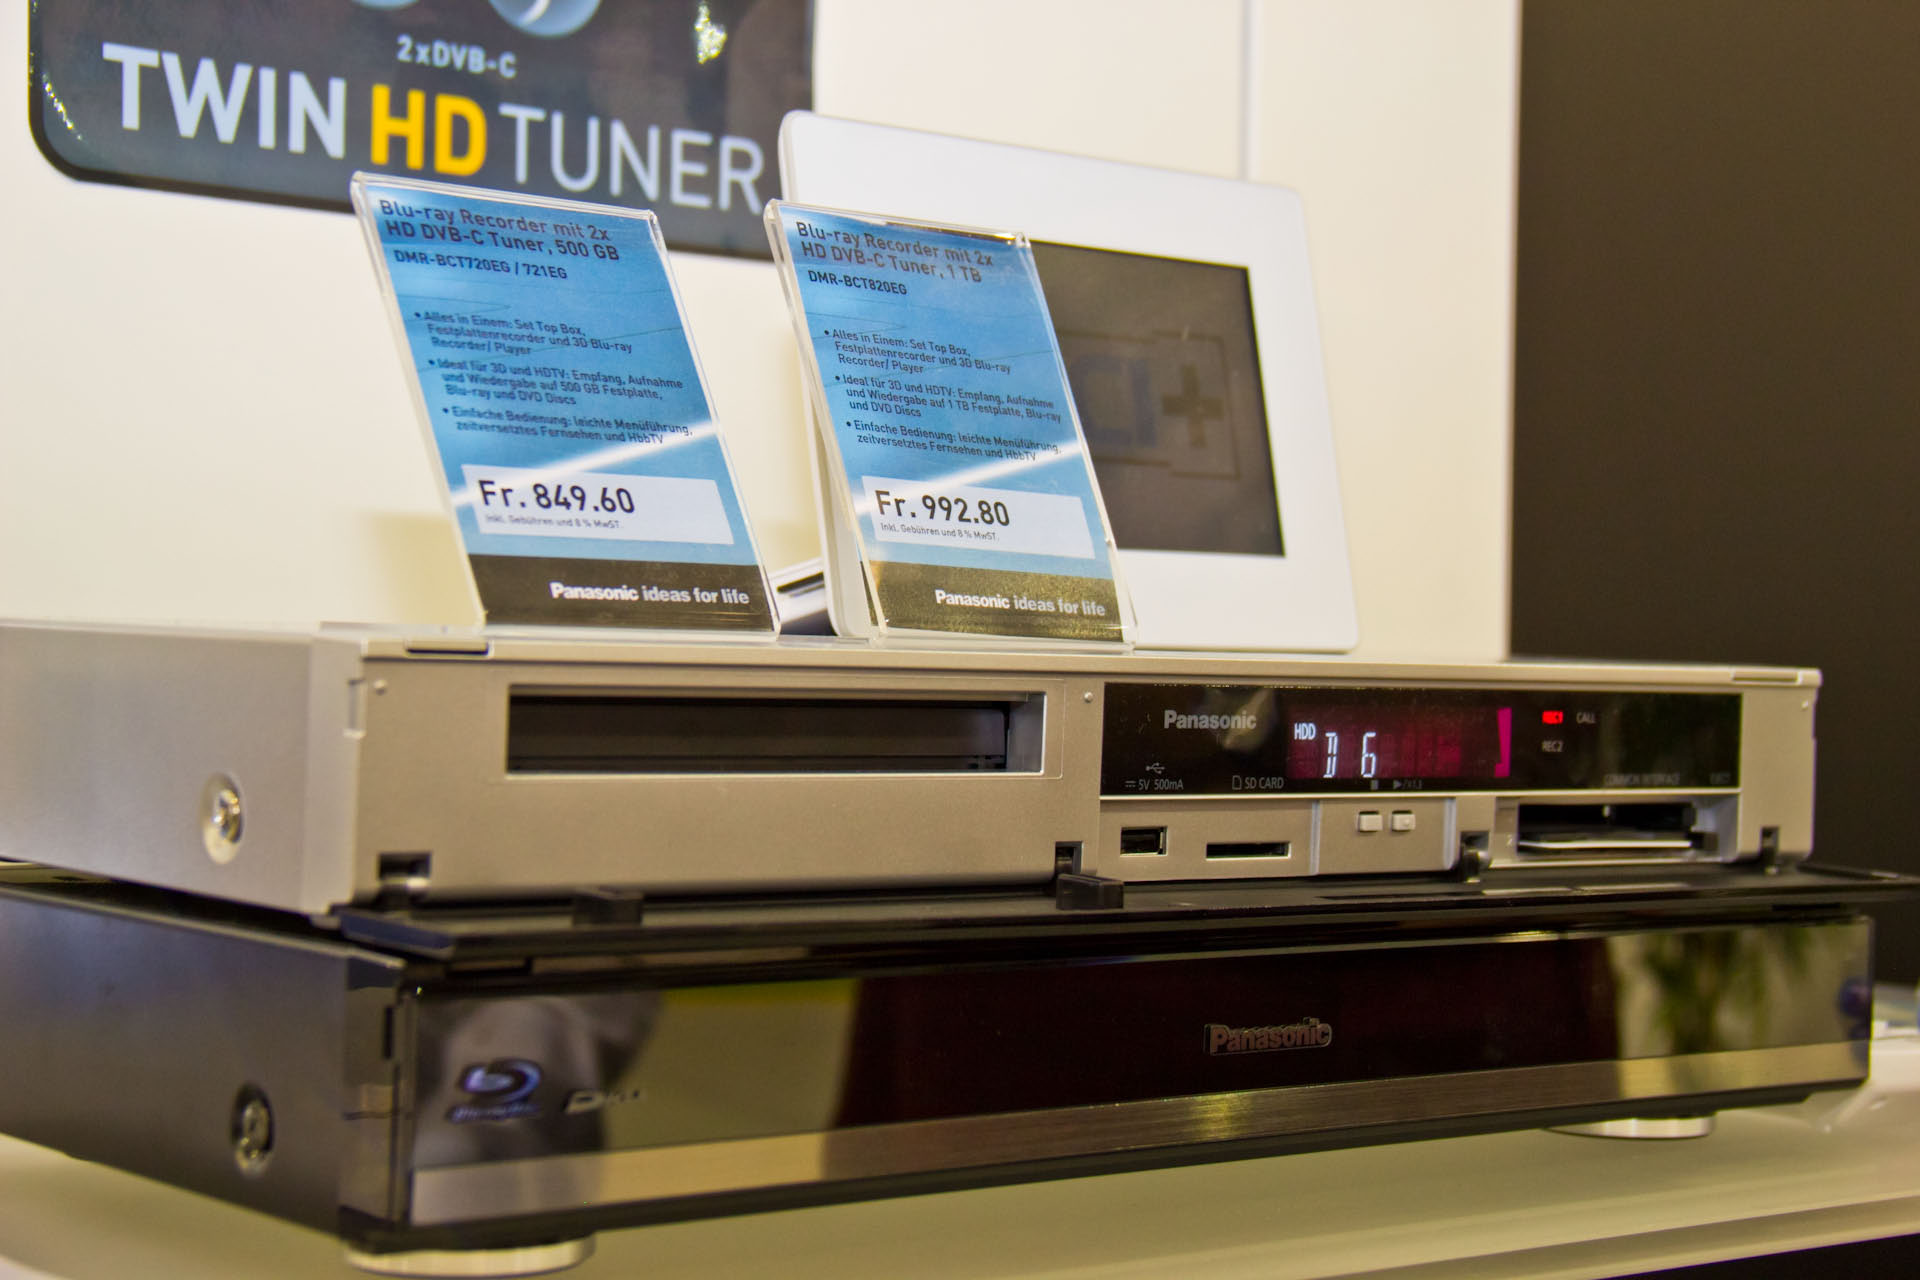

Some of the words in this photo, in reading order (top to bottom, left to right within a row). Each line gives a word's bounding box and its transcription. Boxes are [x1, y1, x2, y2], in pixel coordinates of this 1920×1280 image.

[397, 34, 518, 79] 2xDVB-C
[102, 41, 346, 159] TWIN
[370, 83, 487, 176] HD
[499, 103, 763, 215] TUNER
[380, 200, 454, 225] Blu-ray
[460, 208, 547, 233] Recorder
[553, 222, 585, 238] mit
[588, 225, 610, 241] 2x
[386, 220, 415, 237] HD
[421, 223, 484, 245] DVB-C
[487, 231, 552, 255] Tuner,
[555, 240, 589, 257] 500
[594, 245, 620, 260] GB
[796, 221, 860, 248] Blu-ray
[864, 232, 940, 258] Recorder
[944, 247, 971, 264] mit
[975, 250, 994, 266] 2x
[394, 250, 510, 273] DMR-BCT720EG
[522, 264, 568, 279] 721EG
[801, 241, 827, 258] HD
[831, 245, 886, 268] DVB-C
[888, 254, 945, 279] Tuner,
[946, 264, 955, 279] 1
[960, 266, 983, 283] TB
[808, 270, 908, 295] DMR-BCT820EG
[515, 319, 534, 330] Set
[536, 321, 558, 334] Top
[560, 324, 586, 336] Box,
[549, 336, 570, 346] und
[573, 337, 588, 348] 3D
[590, 339, 632, 354] Blu-ray
[833, 329, 859, 341] Alles
[861, 333, 871, 343] in
[872, 333, 909, 348] Einem:
[909, 338, 927, 350] Set
[927, 341, 947, 354] Top
[949, 343, 971, 356] Box,
[835, 341, 936, 363] Festplattenrecorder
[938, 355, 957, 366] und
[959, 357, 972, 368] 3D
[974, 359, 1011, 375] Blu-ray
[838, 353, 889, 370] Recorder/
[891, 360, 924, 375] Player
[491, 362, 506, 374] 3D
[510, 366, 531, 376] und
[628, 375, 683, 389] Aufnahme
[540, 381, 557, 391] auf
[560, 381, 581, 392] 500
[584, 383, 600, 394] GB
[518, 391, 543, 402] DVD
[545, 393, 576, 405] Discs
[843, 374, 870, 386] Ideal
[870, 376, 886, 388] für
[888, 379, 902, 391] 3D
[904, 383, 923, 393] und
[925, 384, 955, 397] HDTV:
[958, 388, 1005, 405] Empfang,
[1006, 394, 1055, 409] Aufnahme
[846, 388, 866, 398] und
[868, 389, 928, 406] Wiedergabe
[929, 398, 946, 409] auf
[948, 399, 954, 409] 1
[957, 400, 970, 411] TB
[971, 401, 1025, 419] Festplatte,
[1025, 408, 1062, 425] Blu-ray
[849, 400, 869, 411] und
[871, 401, 893, 413] DVD
[895, 404, 922, 417] Discs
[604, 432, 626, 442] und
[628, 431, 663, 444] HbbTV
[853, 420, 898, 435] Einfache
[899, 425, 957, 444] Bedienung:
[958, 432, 992, 446] leichte
[857, 434, 928, 450] zeitversetztes
[929, 441, 983, 457] Fernsehen
[985, 447, 1003, 458] und
[1006, 449, 1036, 461] HbbTV
[478, 479, 526, 508] Fr.
[532, 483, 635, 513] 849.60
[875, 489, 917, 518] Fr.
[921, 494, 1010, 527] 992.80
[880, 522, 900, 532] Inkl.
[900, 524, 940, 536] Gebühren
[940, 527, 956, 537] und
[550, 581, 639, 601] Panasonic
[642, 585, 691, 603] ideas
[693, 586, 718, 603] for
[720, 587, 750, 605] life
[935, 588, 1010, 609] Panasonic
[1013, 594, 1055, 613] ideas
[1058, 596, 1079, 615] for
[1081, 598, 1105, 616] life
[1164, 709, 1257, 730] Panasonic
[1294, 722, 1317, 740] HDD
[1576, 711, 1596, 724] CALL
[1361, 732, 1377, 778] 6
[1138, 780, 1150, 791] 5V
[1154, 778, 1184, 790] 500mA
[1245, 777, 1257, 789] SD
[1258, 776, 1284, 789] CARD
[1207, 1018, 1331, 1054] Panasonic
